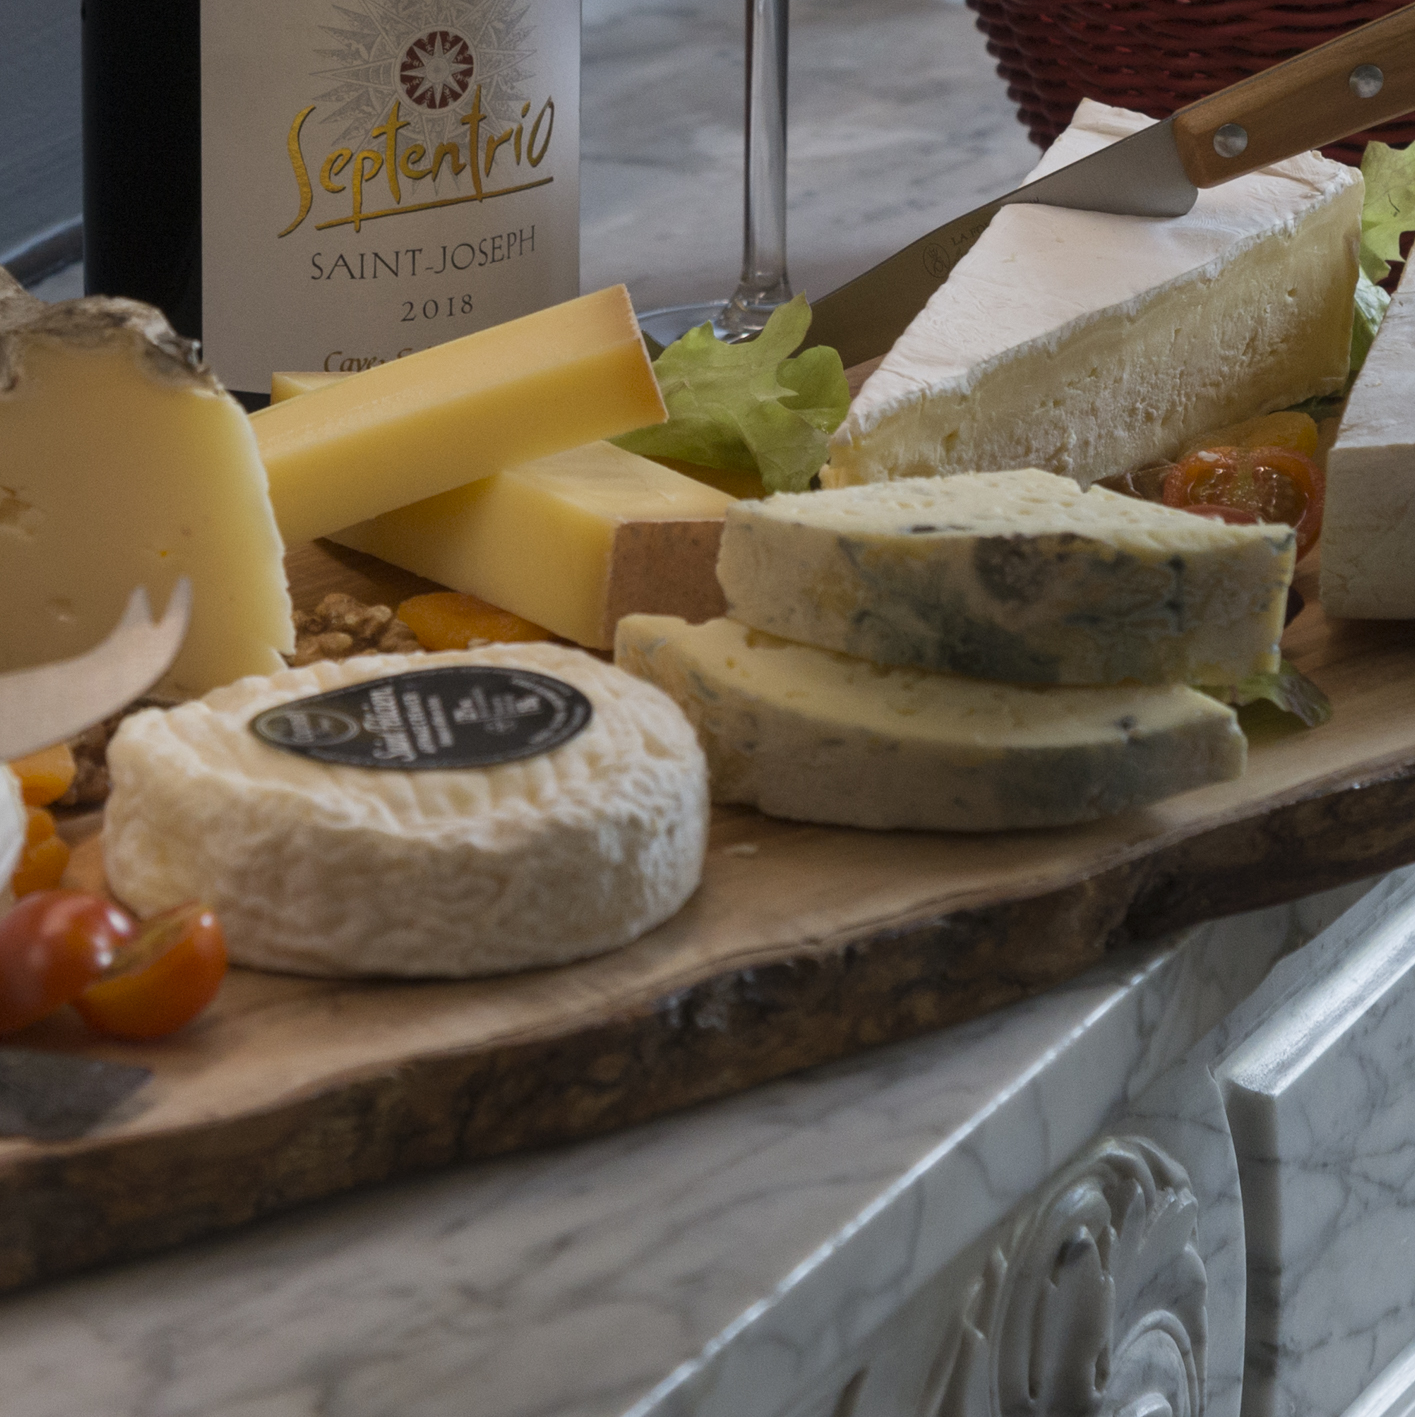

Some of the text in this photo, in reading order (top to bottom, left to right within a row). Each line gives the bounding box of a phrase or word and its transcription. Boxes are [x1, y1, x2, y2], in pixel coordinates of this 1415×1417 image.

[277, 84, 555, 239] Septentrio
[310, 224, 537, 281] SAINT-JOSEPH
[400, 293, 475, 323] 2018
